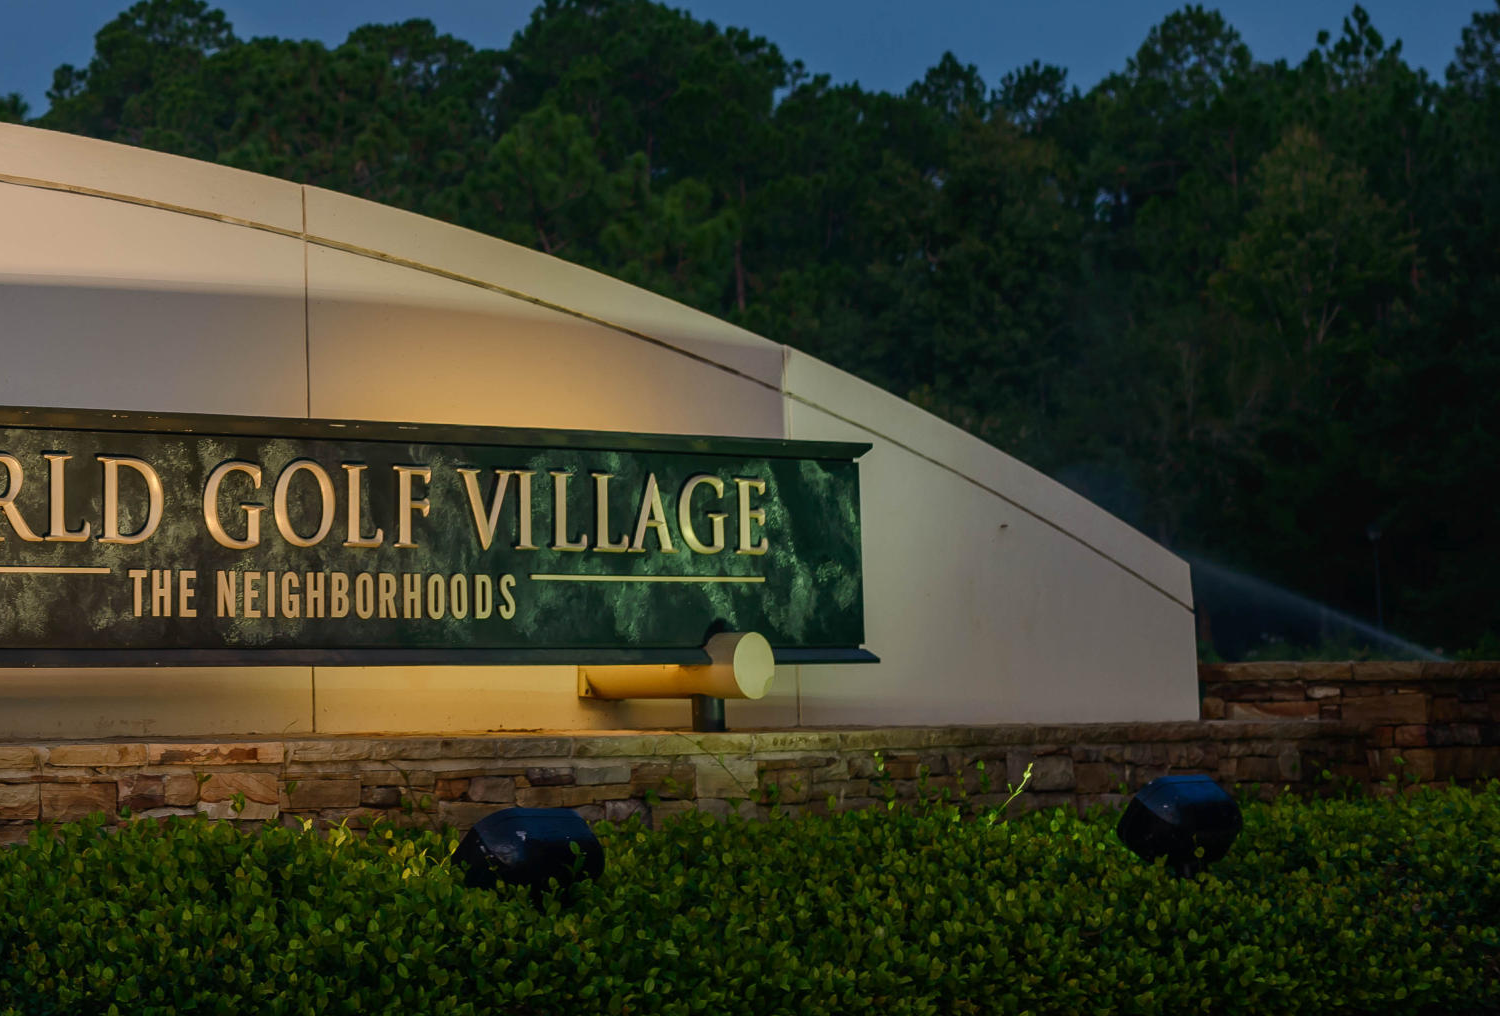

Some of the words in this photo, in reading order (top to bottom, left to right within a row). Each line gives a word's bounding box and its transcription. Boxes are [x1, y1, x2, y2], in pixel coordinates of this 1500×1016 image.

[202, 459, 432, 551] GOLF
[456, 465, 769, 557] VILLAGE
[128, 568, 199, 619] THE
[214, 569, 518, 621] NEIGHBORHOODS
